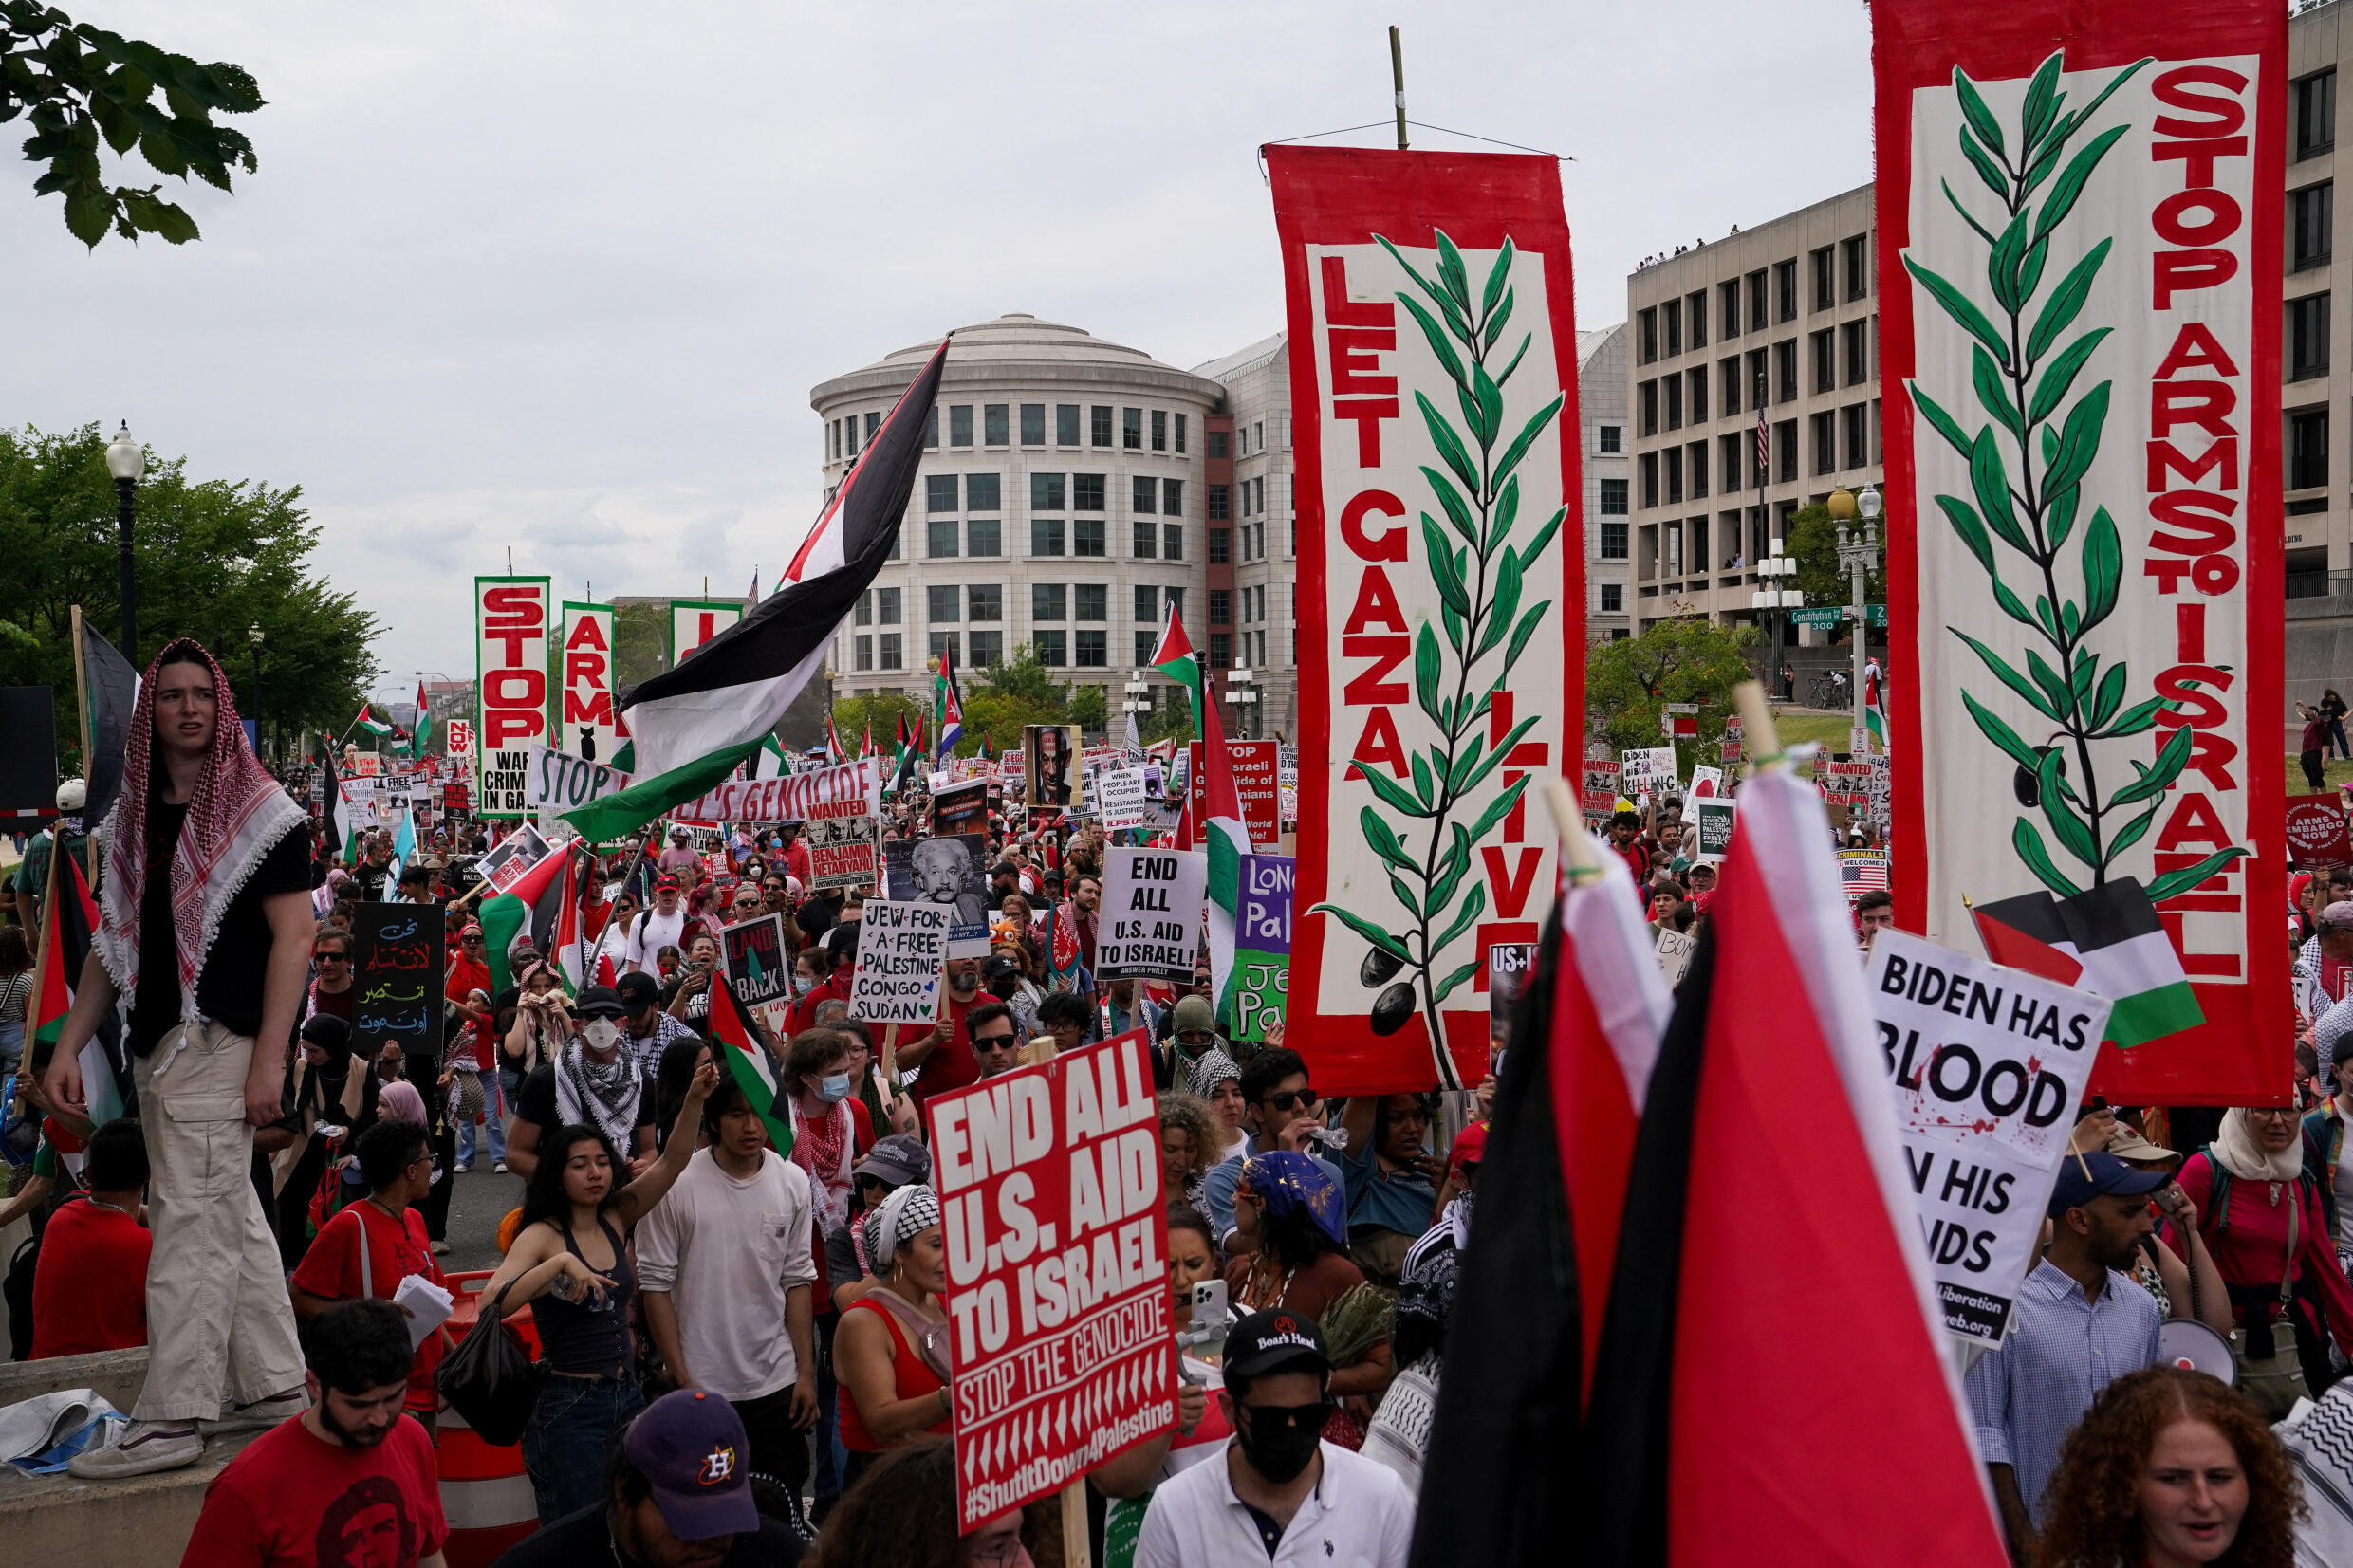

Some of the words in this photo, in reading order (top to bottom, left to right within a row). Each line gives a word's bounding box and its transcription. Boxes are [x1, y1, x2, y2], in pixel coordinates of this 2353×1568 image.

[2151, 65, 2250, 311] STOP
[1320, 255, 1401, 469] LET
[2145, 322, 2240, 557] ARMS
[2285, 535, 2303, 544] LDING
[2143, 553, 2241, 597] TO
[1792, 610, 1832, 622] Constitution
[1339, 489, 1411, 782] GAZA
[1812, 622, 1834, 631] 300
[483, 587, 546, 749] STOP
[450, 722, 468, 753] NOW
[1004, 754, 1025, 763] SIEGE
[1232, 760, 1269, 772] sraeli
[1583, 759, 1621, 774] WANTED
[1004, 766, 1025, 775] NOW!
[1111, 772, 1132, 781] WHEN
[1829, 762, 1872, 776] WANTED
[356, 780, 372, 789] YOU
[387, 776, 410, 787] FREE
[484, 770, 526, 790] CRIM
[538, 749, 610, 807] STOP
[741, 762, 869, 822] GENOCIDE
[1102, 780, 1127, 789] PEOPLE
[1260, 774, 1273, 785] of
[348, 788, 376, 798] TANYAHU
[1106, 787, 1139, 797] OCCUPIED
[2152, 602, 2242, 978] ISRAEL
[484, 791, 499, 810] IN
[505, 791, 539, 810] GA
[807, 799, 867, 821] WANTED
[1069, 803, 1092, 815] NOW!
[1104, 798, 1144, 808] RESISTANCE
[1113, 806, 1144, 816] JUSTIFIED
[2295, 815, 2330, 826] ARMS
[1106, 819, 1130, 828] ILPS
[1702, 825, 1732, 834] PALESTINE
[2286, 820, 2344, 834] EMBARGO
[831, 839, 871, 847] CRIMINAL
[2301, 829, 2330, 840] NOW
[811, 843, 872, 864] BENJAMIN
[1838, 850, 1885, 859] CRIMINALS
[2317, 840, 2333, 850] FREE
[712, 858, 727, 866] ISRA
[812, 858, 874, 877] NETANYAHU
[1130, 856, 1178, 881] END
[500, 864, 519, 883] GAZA
[815, 876, 876, 889] ANSWERCOALITION.ORG
[1249, 858, 1296, 895] LON
[1129, 887, 1171, 913] ALL
[865, 905, 905, 928] JEW
[910, 909, 945, 929] FOR
[380, 917, 418, 940] نحن
[1114, 920, 1146, 940] U.S.
[1152, 921, 1184, 942] AID
[730, 925, 775, 960] LAND
[875, 931, 889, 949] A
[896, 932, 940, 955] FREE
[862, 952, 941, 976] PALESTINE
[1100, 945, 1121, 964] TO
[1124, 944, 1195, 968] ISRAEL!
[1491, 945, 1541, 973] US+I
[1121, 965, 1146, 975] ANSWER
[1146, 966, 1170, 976] PHILLY
[735, 968, 781, 1003] BACK
[857, 977, 922, 997] CONGO
[854, 1000, 918, 1021] SUDAN
[1880, 953, 2002, 1026] BIDEN
[2008, 993, 2092, 1052] HAS
[1875, 1019, 2067, 1129] BLOOD
[932, 1073, 1055, 1191] END
[1065, 1038, 1156, 1149] ALL
[1903, 1145, 1935, 1195] N
[1939, 1157, 2017, 1215] HIS
[944, 1170, 1058, 1288] U.S.
[1068, 1128, 1159, 1242] AID
[1927, 1217, 1998, 1273] NDS
[950, 1282, 1010, 1366] TO
[1016, 1214, 1166, 1337] ISRAEL
[1936, 1284, 2003, 1315] Liberation
[1257, 1332, 1289, 1351] Boar's
[958, 1367, 1017, 1426] STOP
[1019, 1337, 1068, 1397] THE
[1070, 1290, 1168, 1375] GENOCIDE
[707, 1451, 731, 1479] H
[963, 1398, 1175, 1524] #ShutItDown4Palestine
